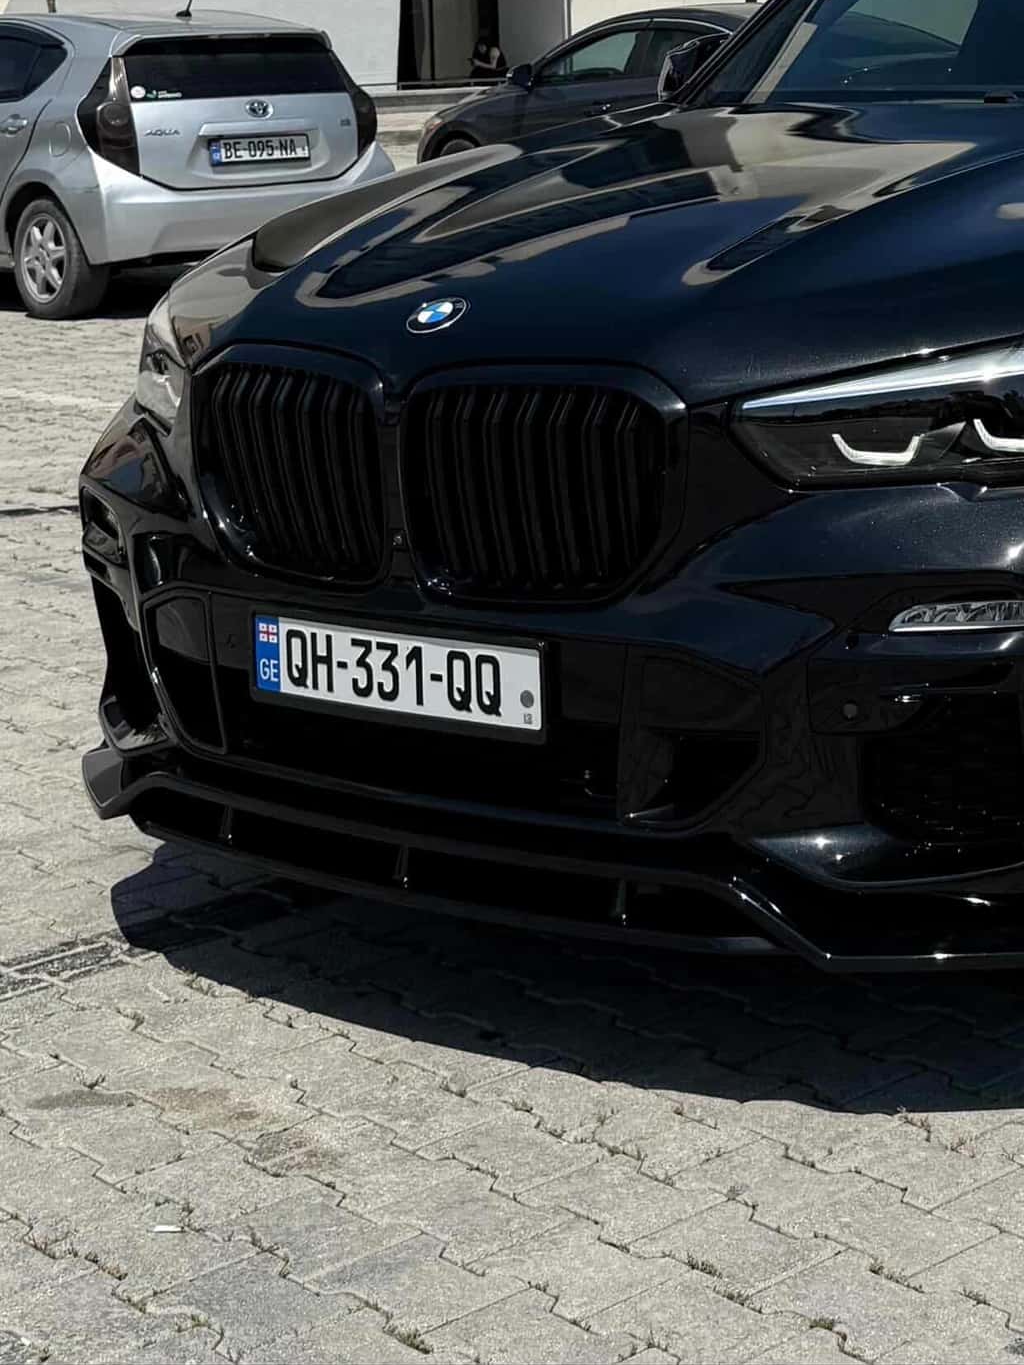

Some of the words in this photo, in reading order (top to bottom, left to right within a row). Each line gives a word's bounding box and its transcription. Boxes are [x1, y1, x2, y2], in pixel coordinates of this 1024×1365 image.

[223, 138, 297, 160] BE-095-NA
[259, 658, 279, 682] GE
[285, 628, 502, 717] QH-331-QQ
